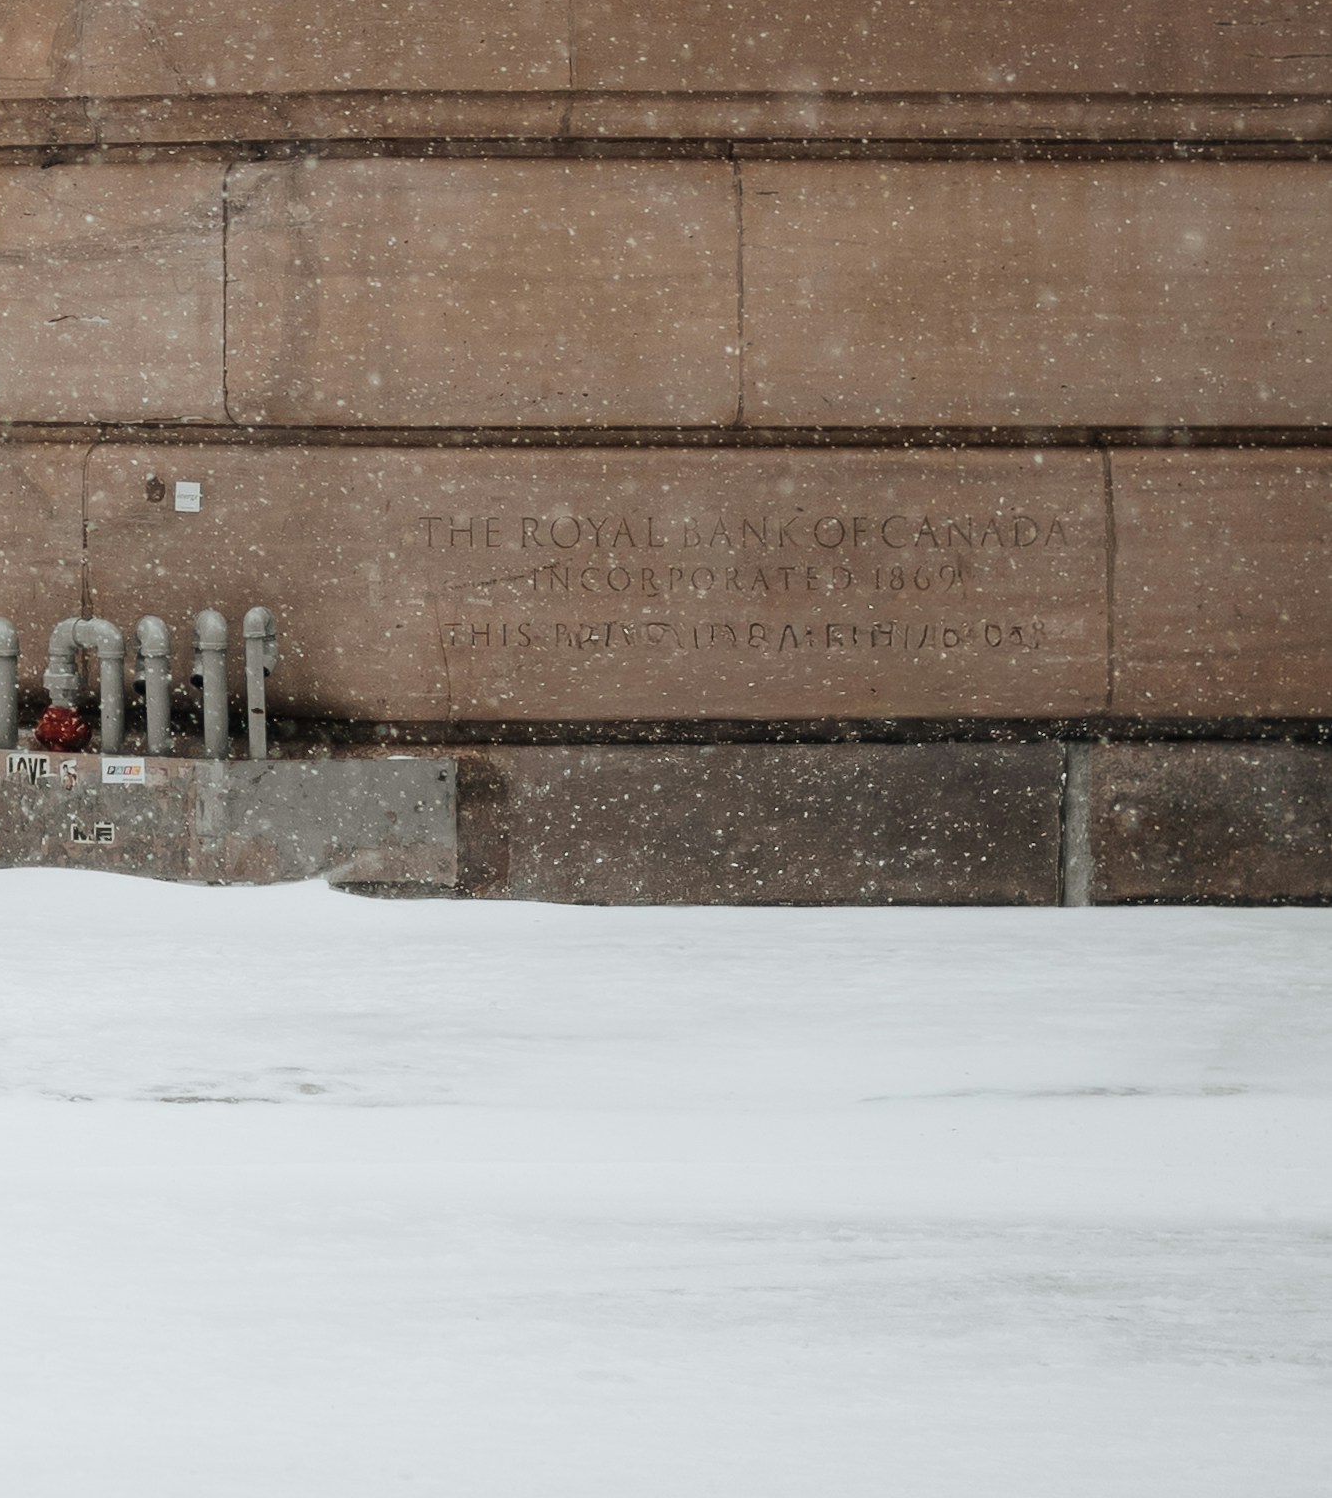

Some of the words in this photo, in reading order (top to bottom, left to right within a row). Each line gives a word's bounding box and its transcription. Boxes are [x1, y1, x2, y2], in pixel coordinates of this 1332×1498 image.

[419, 516, 503, 548] THE
[521, 515, 665, 549] ROYAL
[684, 515, 799, 548] BANK
[814, 515, 868, 549] OF
[881, 514, 1069, 549] CANADA
[532, 566, 852, 592] INCORPORATED
[874, 564, 957, 592] 1869
[444, 622, 532, 648] THIS
